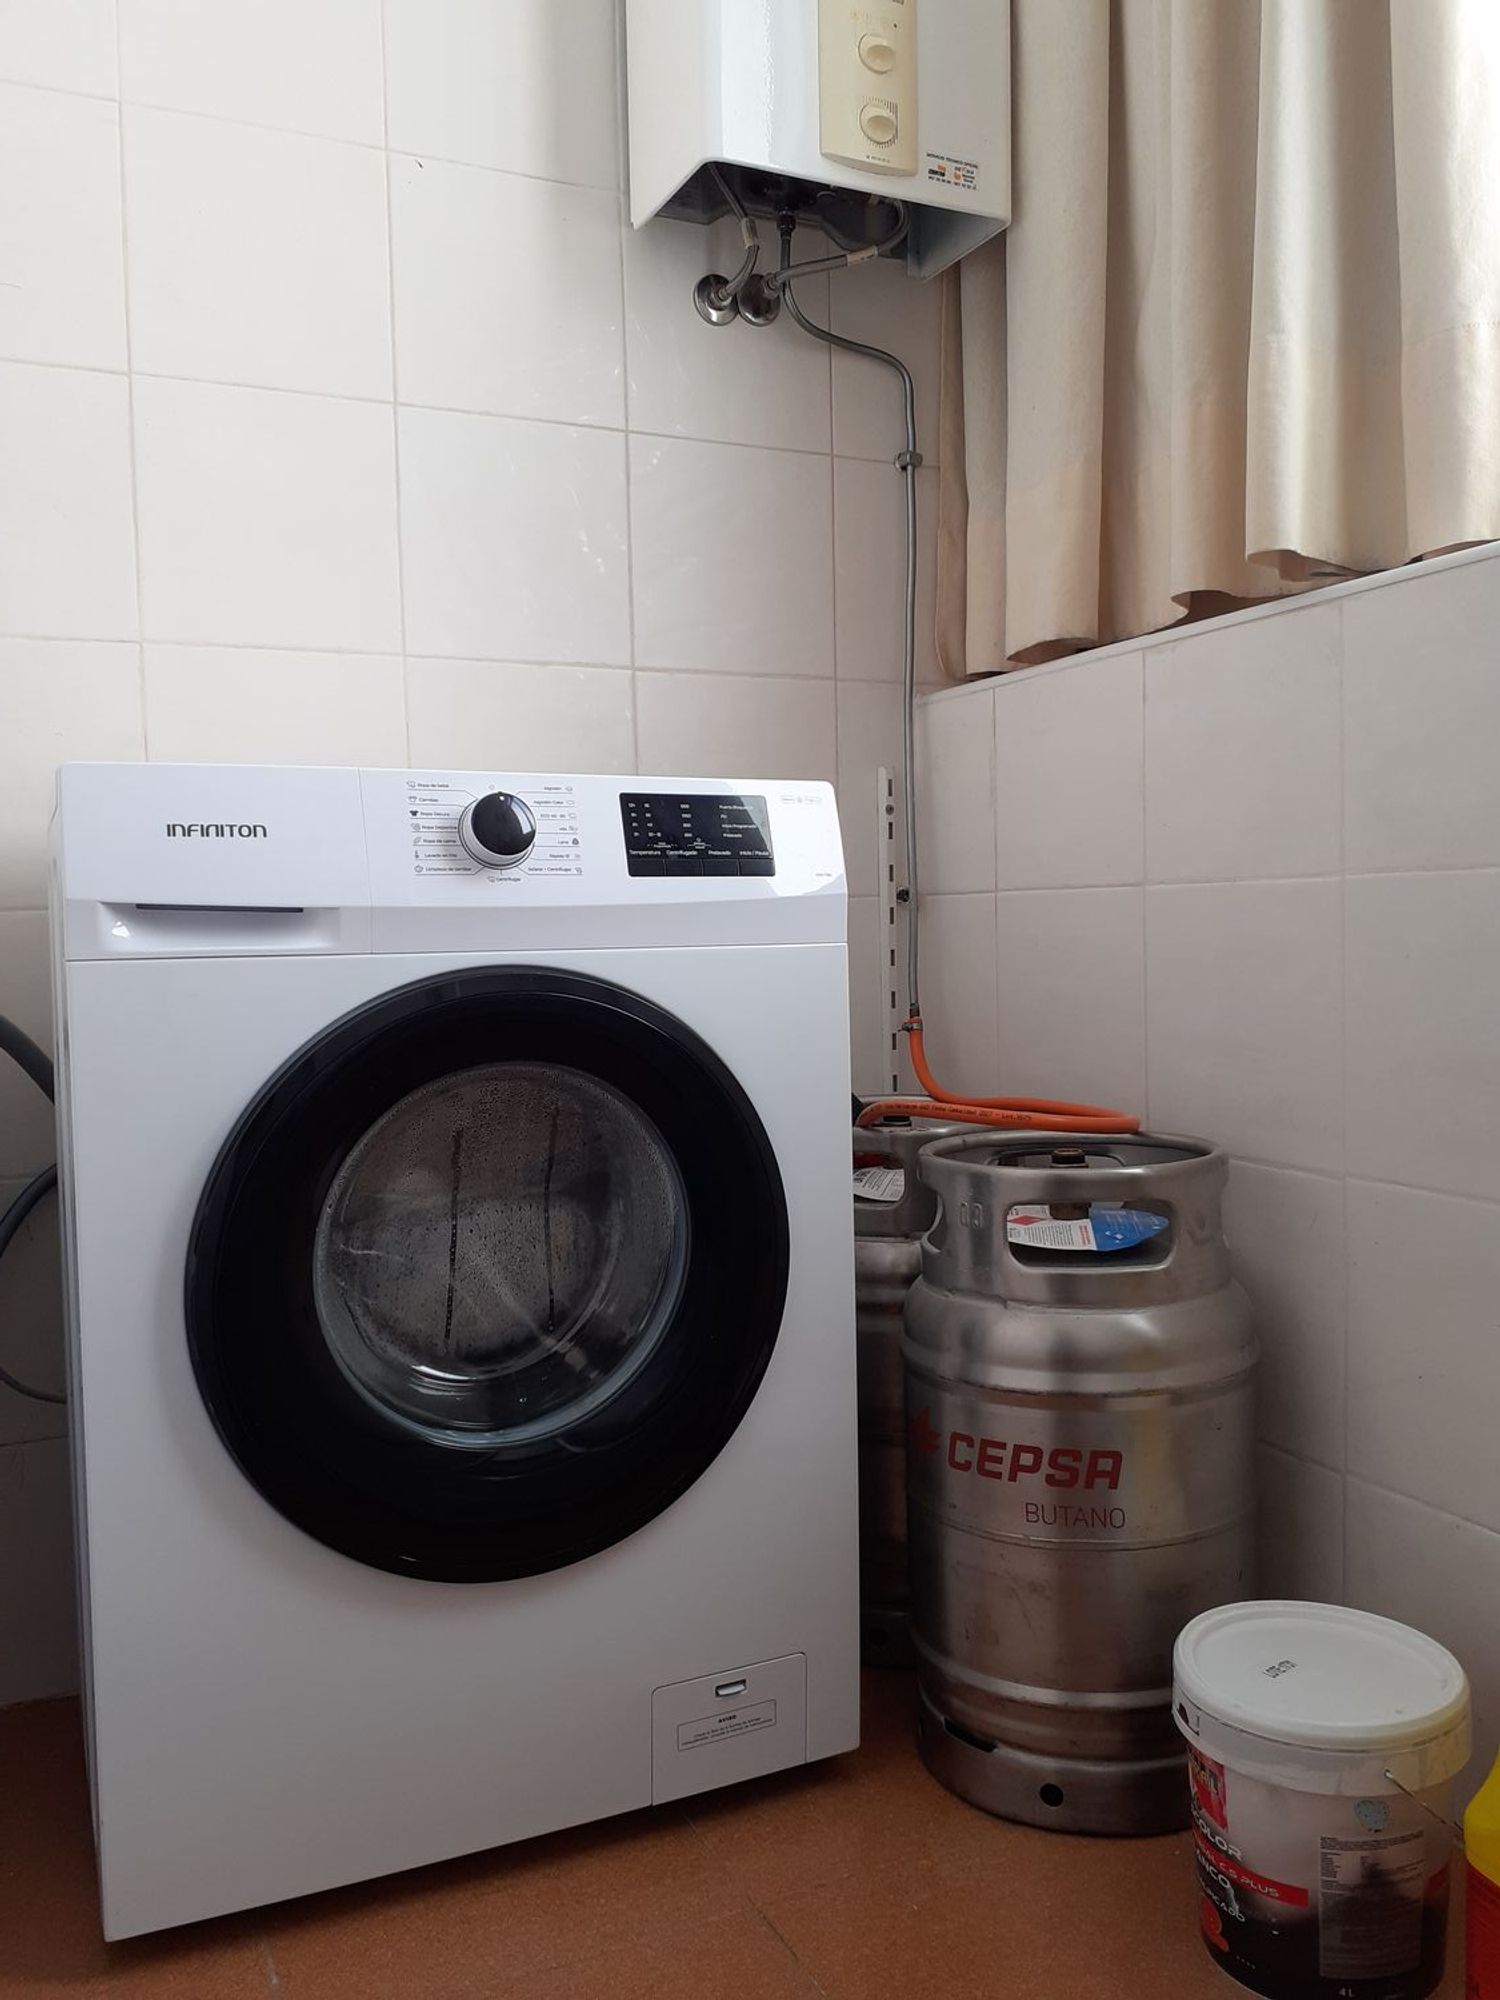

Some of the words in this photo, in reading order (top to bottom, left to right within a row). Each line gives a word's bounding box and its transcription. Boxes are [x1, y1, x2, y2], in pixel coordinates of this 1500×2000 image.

[166, 823, 268, 838] INFINITON
[947, 1430, 1123, 1490] CEPSA
[1024, 1501, 1127, 1529] BUTANO
